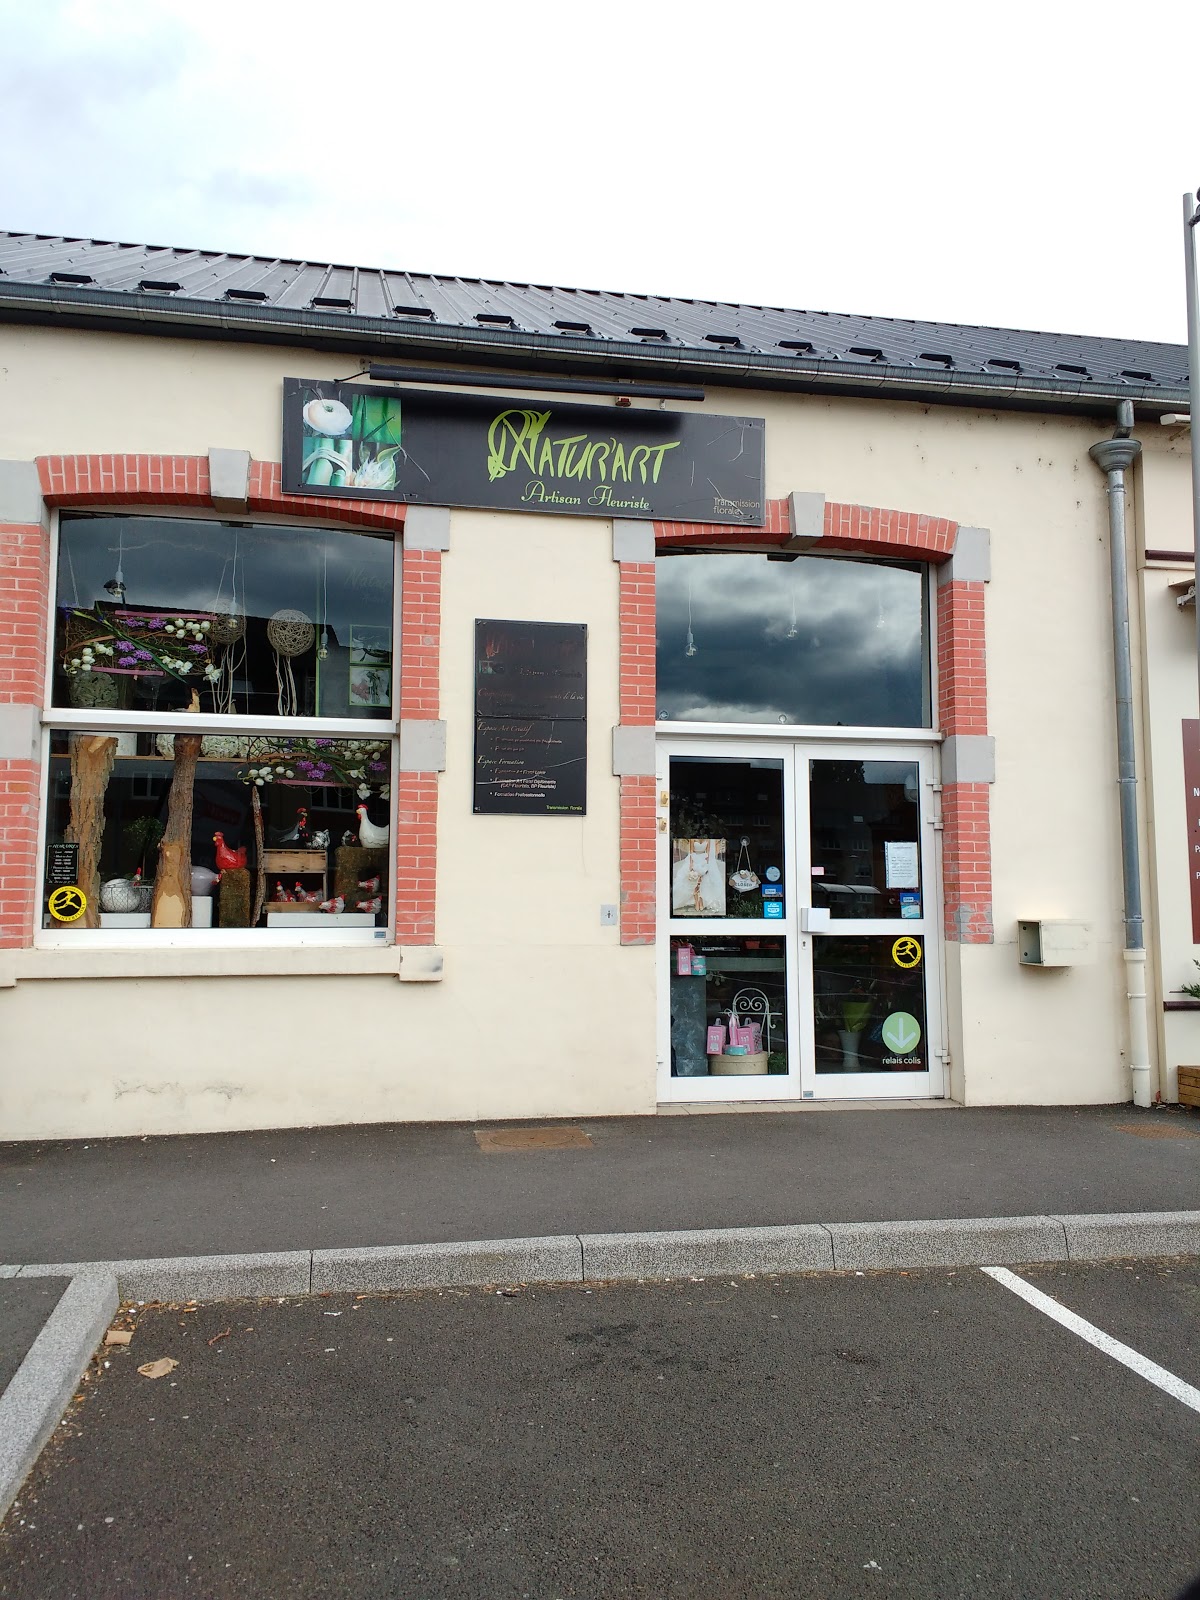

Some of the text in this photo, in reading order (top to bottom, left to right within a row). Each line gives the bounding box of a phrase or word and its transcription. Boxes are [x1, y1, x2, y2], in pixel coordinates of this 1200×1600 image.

[521, 480, 650, 510] Artisan Fleuriste
[713, 497, 760, 509] Transmission
[713, 506, 741, 515] florale
[882, 1056, 921, 1065] relais colis
